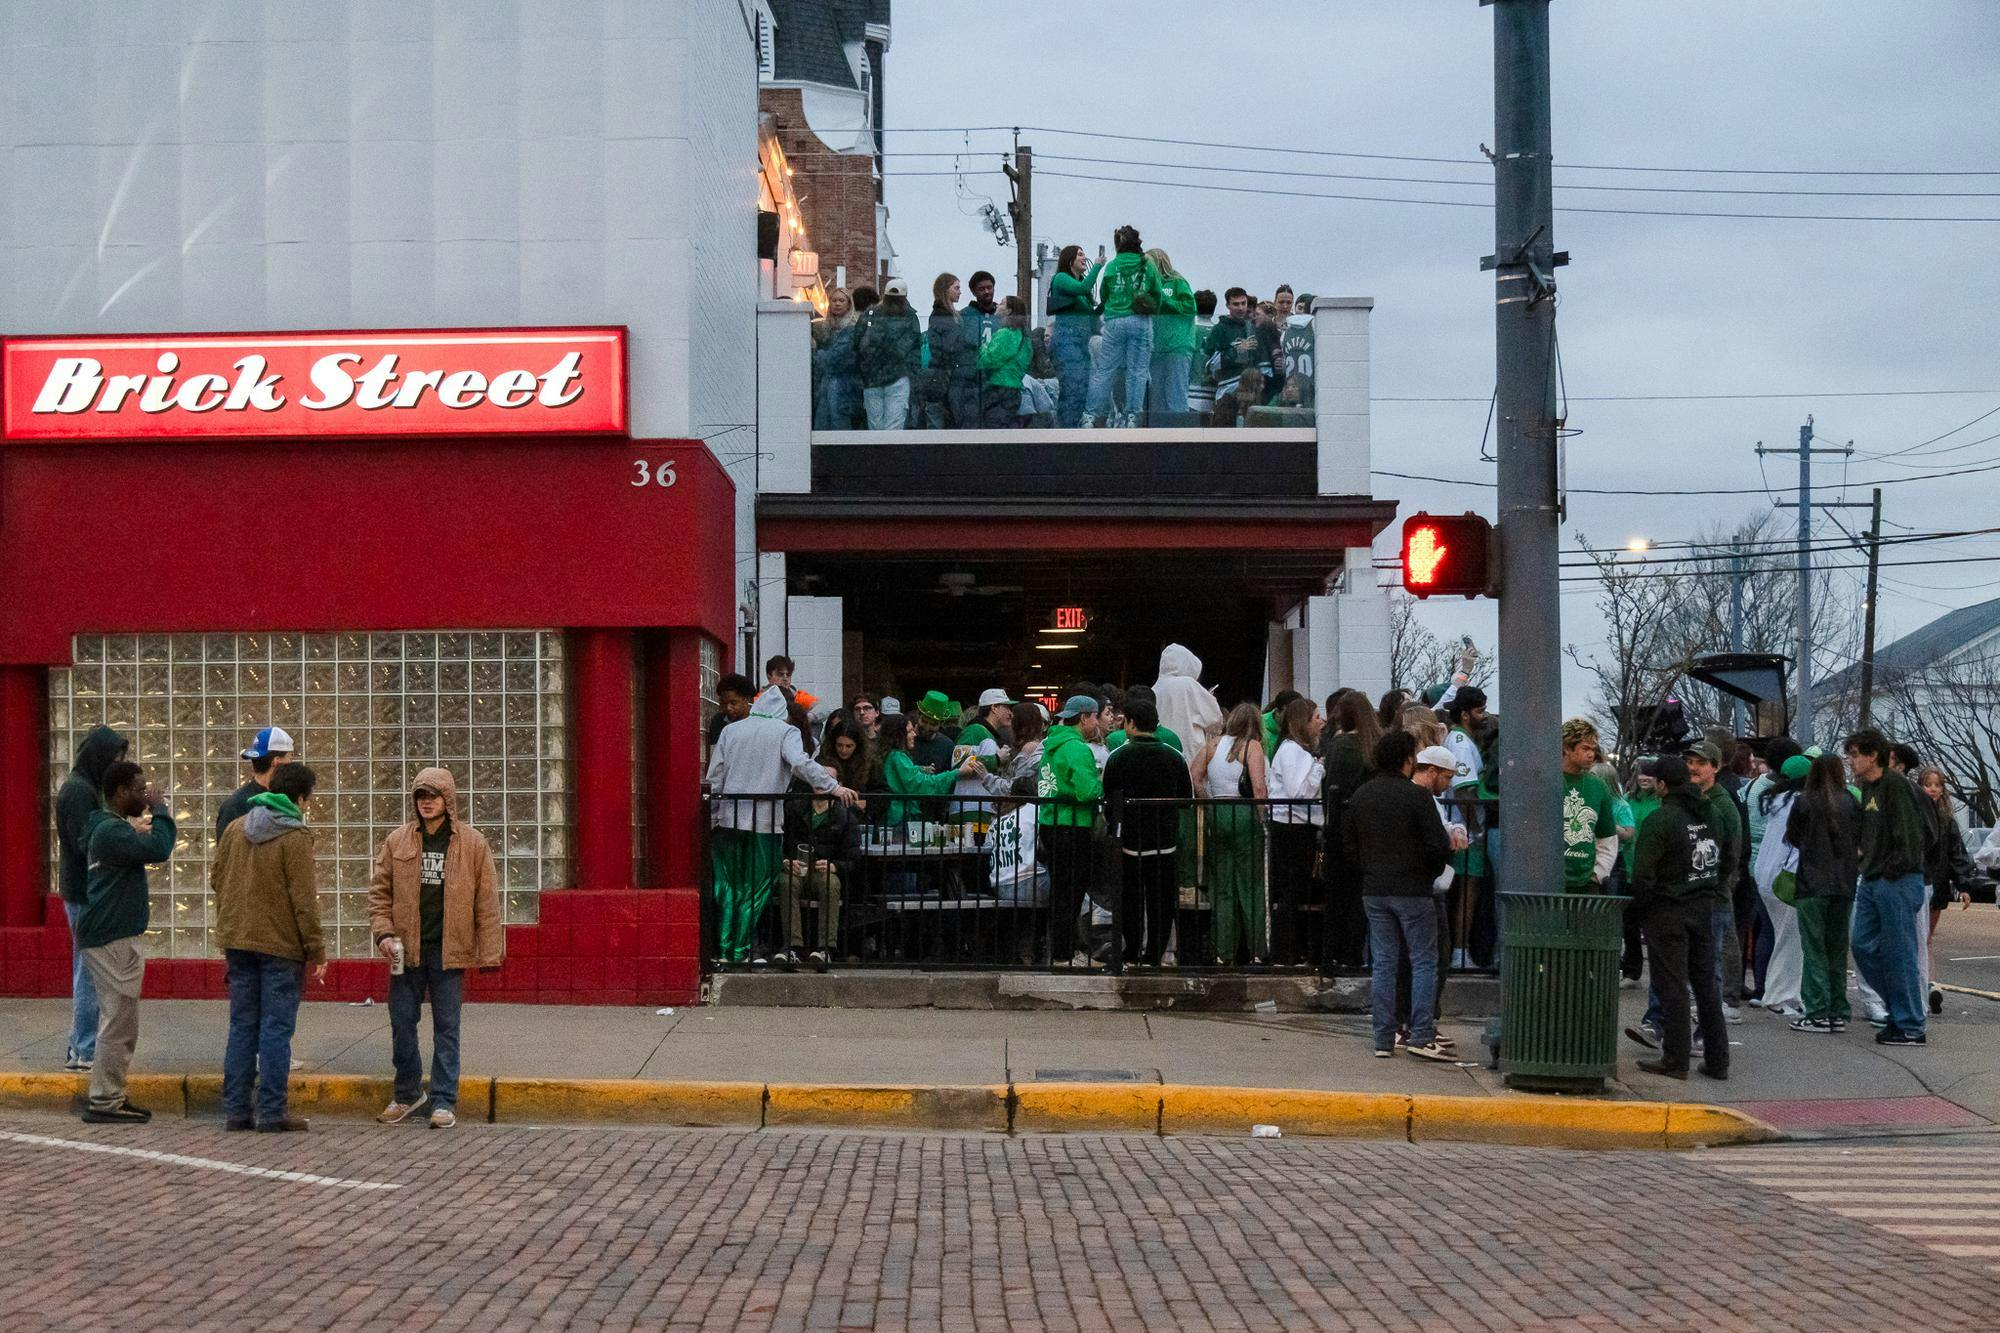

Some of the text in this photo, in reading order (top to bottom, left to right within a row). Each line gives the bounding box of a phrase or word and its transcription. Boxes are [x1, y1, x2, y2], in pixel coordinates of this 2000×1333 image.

[32, 351, 584, 414] Brick Street
[631, 459, 676, 487] 36
[1057, 608, 1083, 628] EXIT
[421, 858, 444, 871] UM
[989, 847, 1023, 873] DINK
